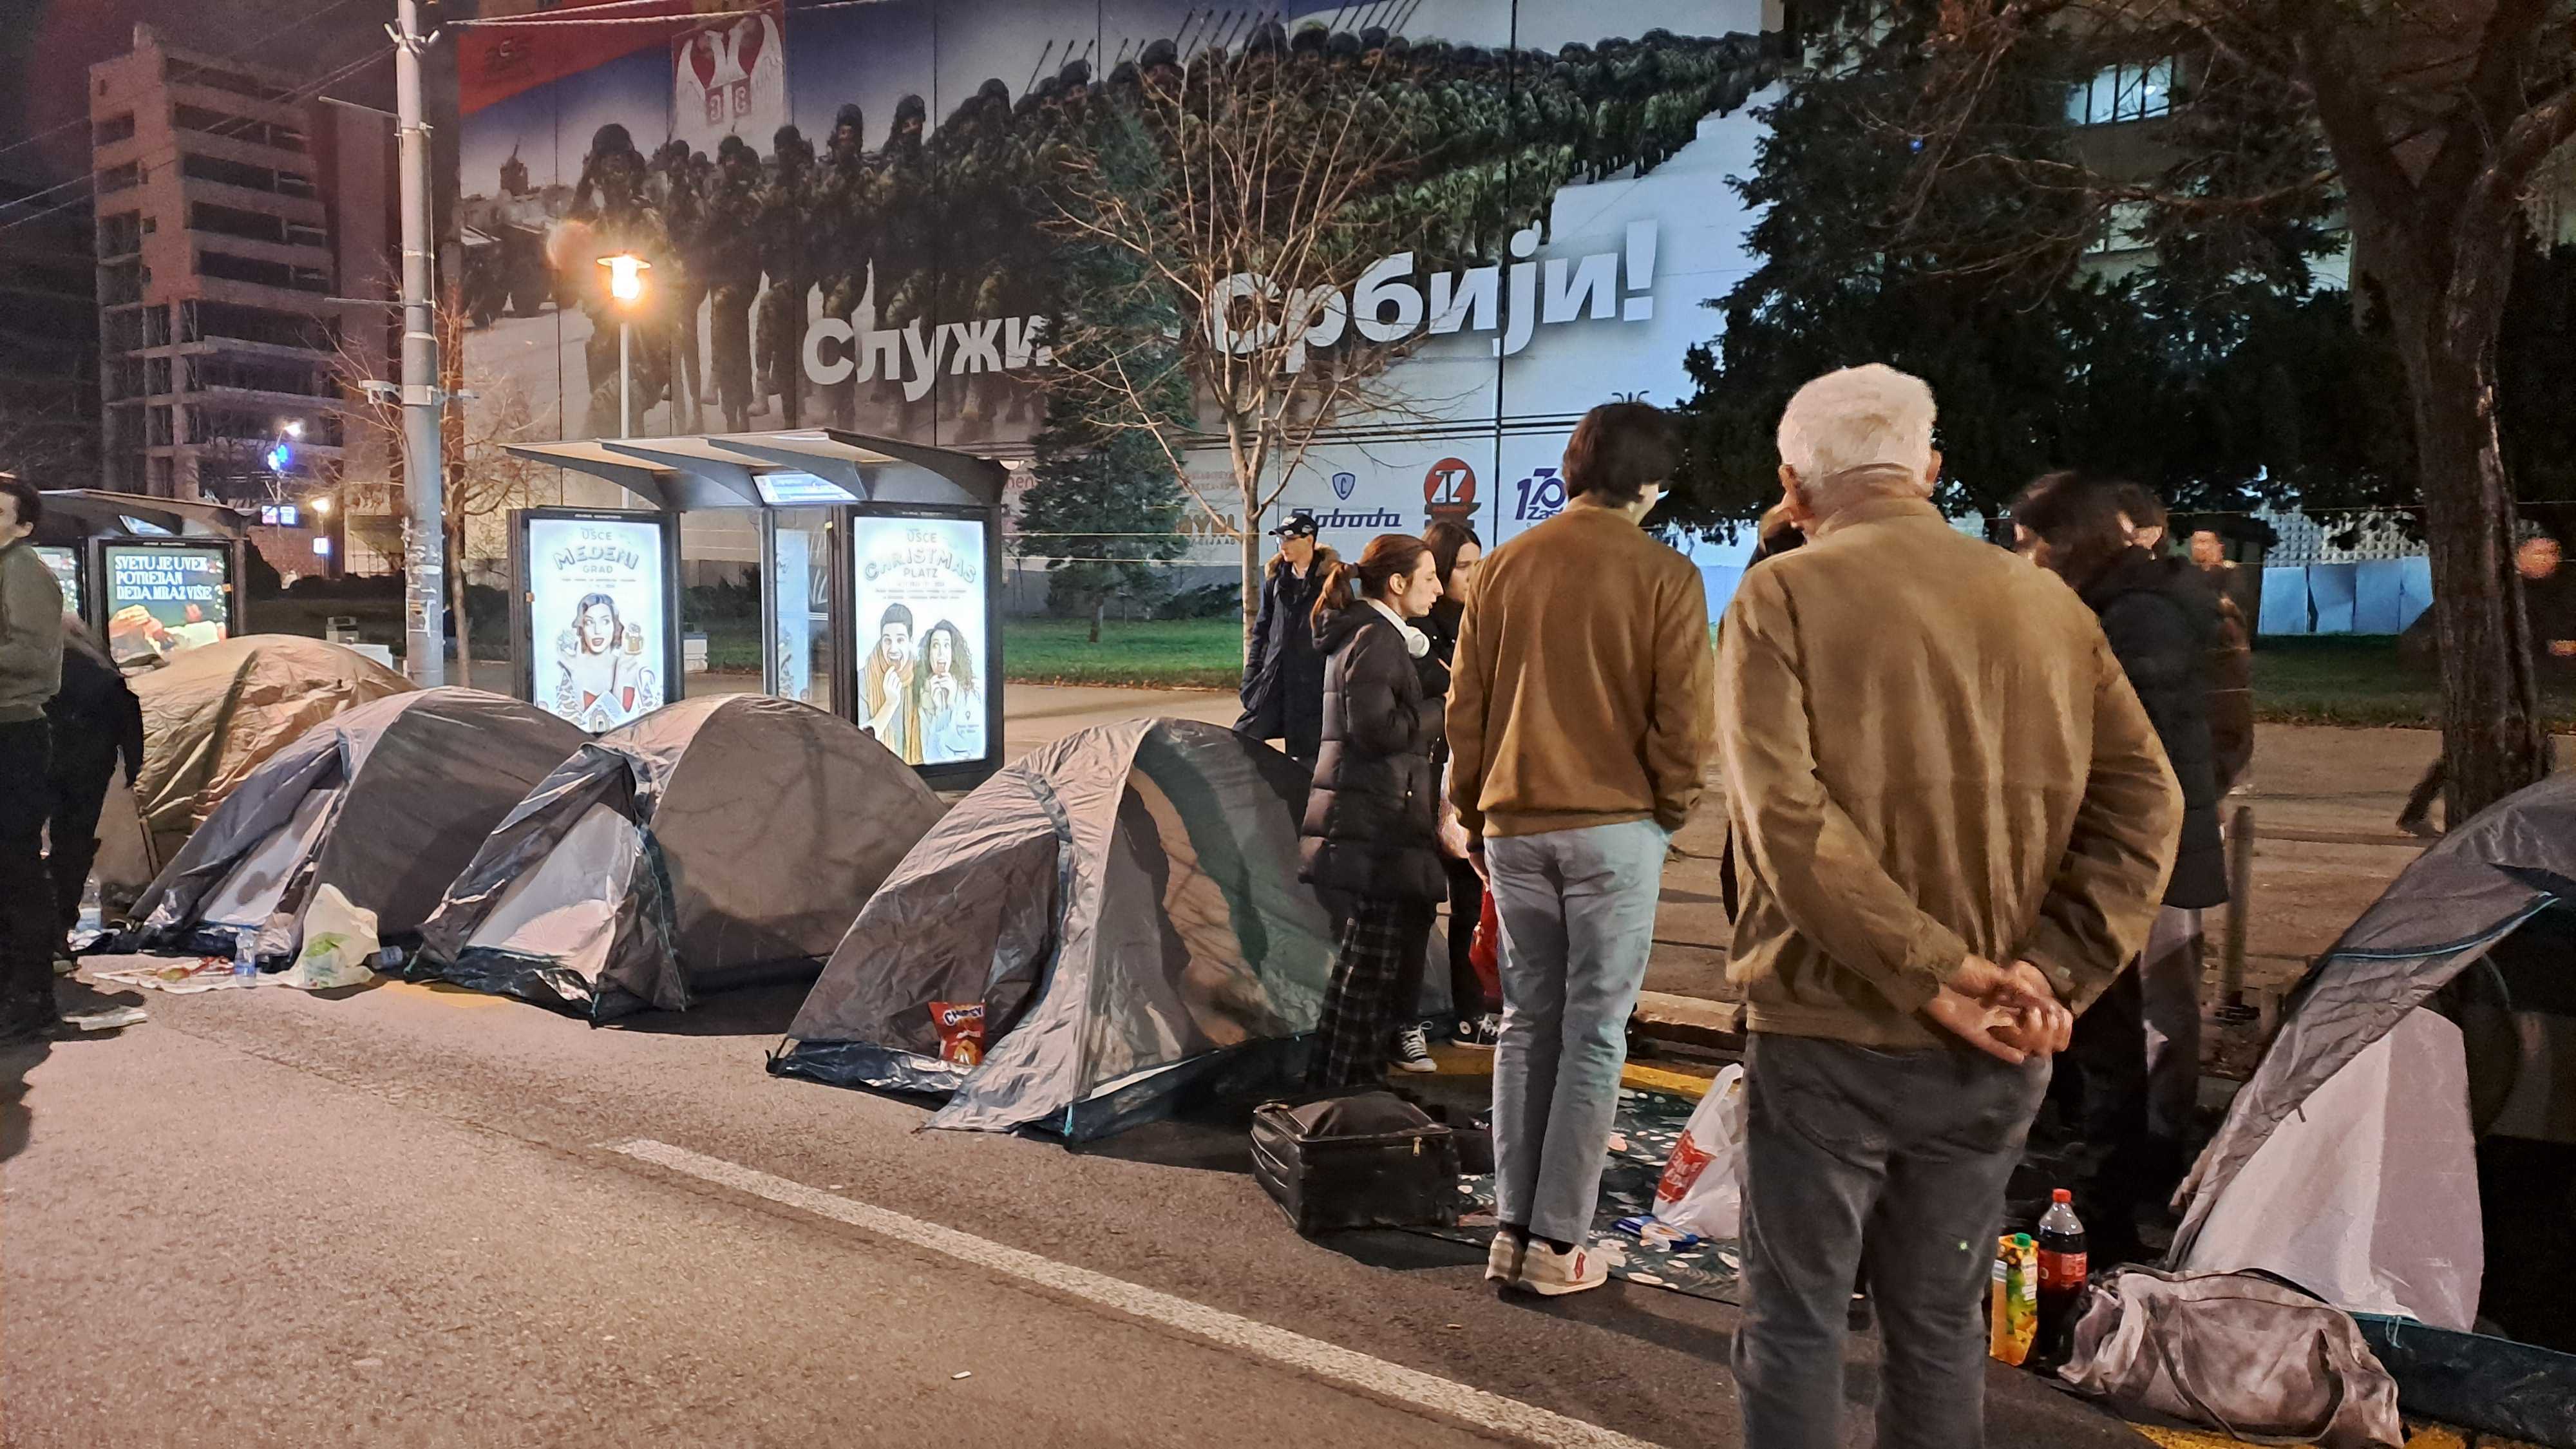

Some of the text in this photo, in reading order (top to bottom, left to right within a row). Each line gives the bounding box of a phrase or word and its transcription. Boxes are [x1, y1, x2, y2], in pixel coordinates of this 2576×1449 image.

[1209, 218, 1658, 372] Србији!
[803, 315, 1063, 402] Служи
[1515, 468, 1567, 520] 170
[115, 555, 208, 571] SVETU JE UVEK
[553, 545, 639, 570] MEDENI
[865, 548, 976, 583] CHRISTMAS
[116, 571, 183, 585] POTREBAN
[904, 567, 938, 578] PLATZ
[117, 586, 153, 600] DEDA
[153, 586, 186, 600] MRAZ
[943, 1006, 984, 1025] CHIPSY
